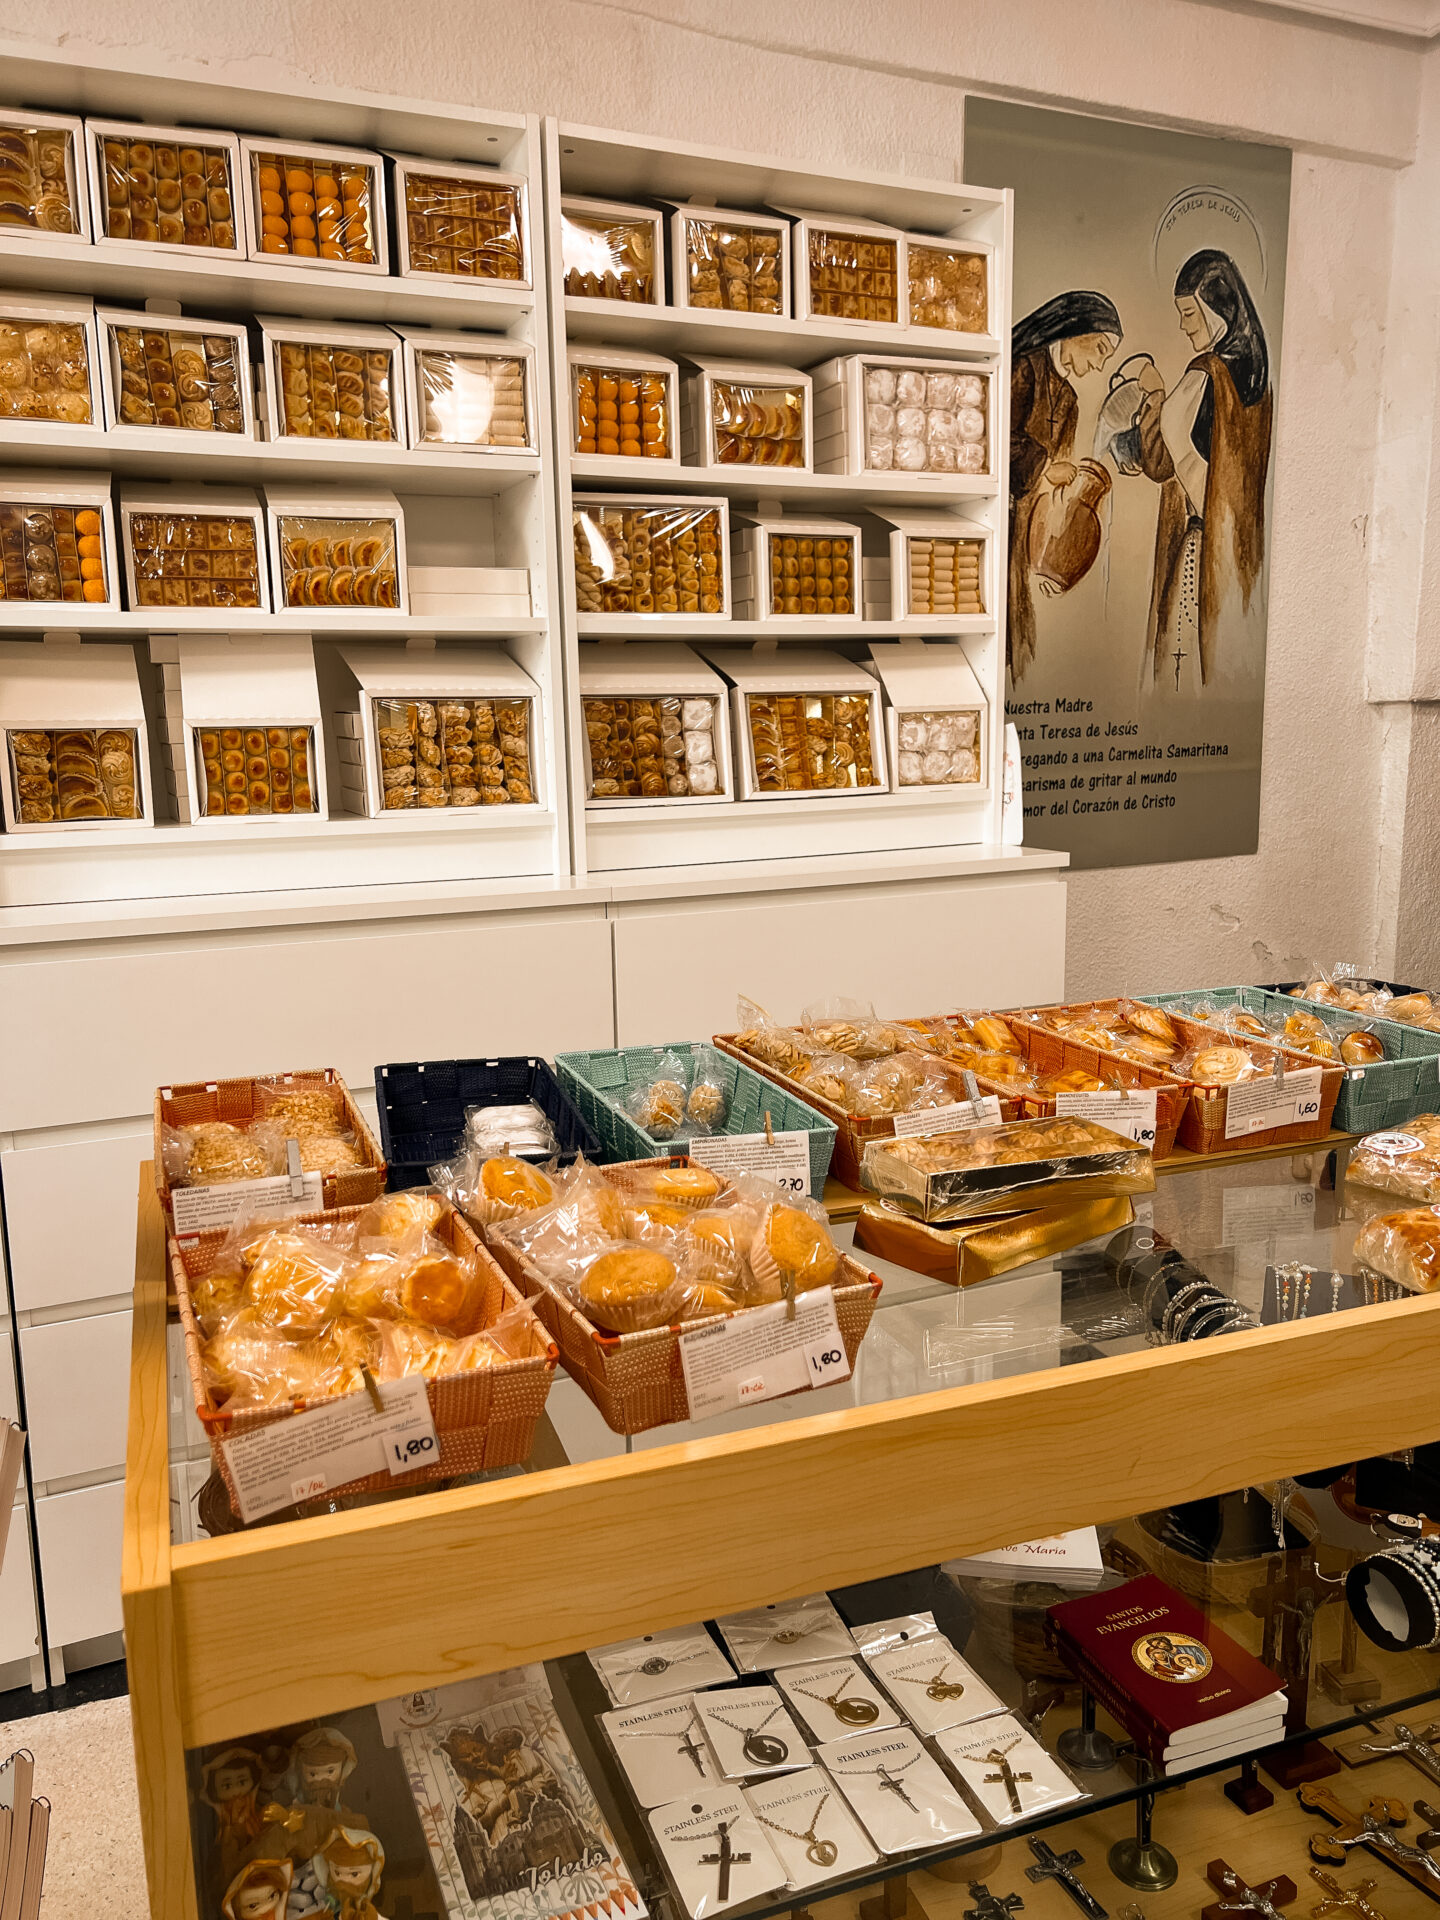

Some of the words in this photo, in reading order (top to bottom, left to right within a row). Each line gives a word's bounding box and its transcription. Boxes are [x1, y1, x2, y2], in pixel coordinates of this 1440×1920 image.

[1208, 200, 1217, 209] DE
[1055, 698, 1093, 713] Madre
[1017, 726, 1035, 741] nta
[1040, 724, 1081, 740] Teresa
[1086, 723, 1100, 738] de
[1104, 720, 1139, 737] Jesús
[1021, 751, 1068, 769] regando
[1072, 752, 1079, 764] a
[1083, 751, 1103, 763] una
[1108, 746, 1162, 762] Carmelita
[1167, 743, 1229, 759] Samaritana
[1070, 775, 1085, 789] de
[1089, 773, 1123, 791] gritar
[1126, 771, 1136, 785] al
[1141, 770, 1177, 784] mundo
[1022, 805, 1046, 818] mor
[1050, 800, 1068, 816] del
[1073, 797, 1119, 814] Corazón
[1124, 797, 1137, 810] de
[1142, 794, 1176, 809] Cristo
[1299, 1103, 1318, 1116] 1,60
[1134, 1128, 1155, 1142] 1,80
[175, 1187, 210, 1197] TOLEDANAS
[812, 1350, 842, 1372] 1,80
[228, 1430, 266, 1447] COCADAS
[394, 1436, 433, 1463] 1,80
[1023, 1544, 1066, 1555] Maria
[1096, 1606, 1170, 1635] EVANGELIOS
[1105, 1605, 1143, 1621] SANTOS
[886, 1661, 925, 1677] STAINLESS
[926, 1655, 949, 1665] STEEL
[788, 1673, 829, 1687] STAINLESS
[830, 1667, 854, 1676] STEEL
[706, 1703, 749, 1713] STAINLESS
[751, 1700, 777, 1708] STEEL
[618, 1711, 663, 1728] STAINLESS
[837, 1748, 881, 1763] STAINLESS
[881, 1742, 909, 1755] STEEL
[953, 1737, 996, 1755] STAINLESS
[997, 1730, 1022, 1741] STEEL
[804, 1785, 831, 1798] STEEL
[663, 1813, 712, 1835] STAINLESS
[518, 1847, 608, 1895] Toledo
